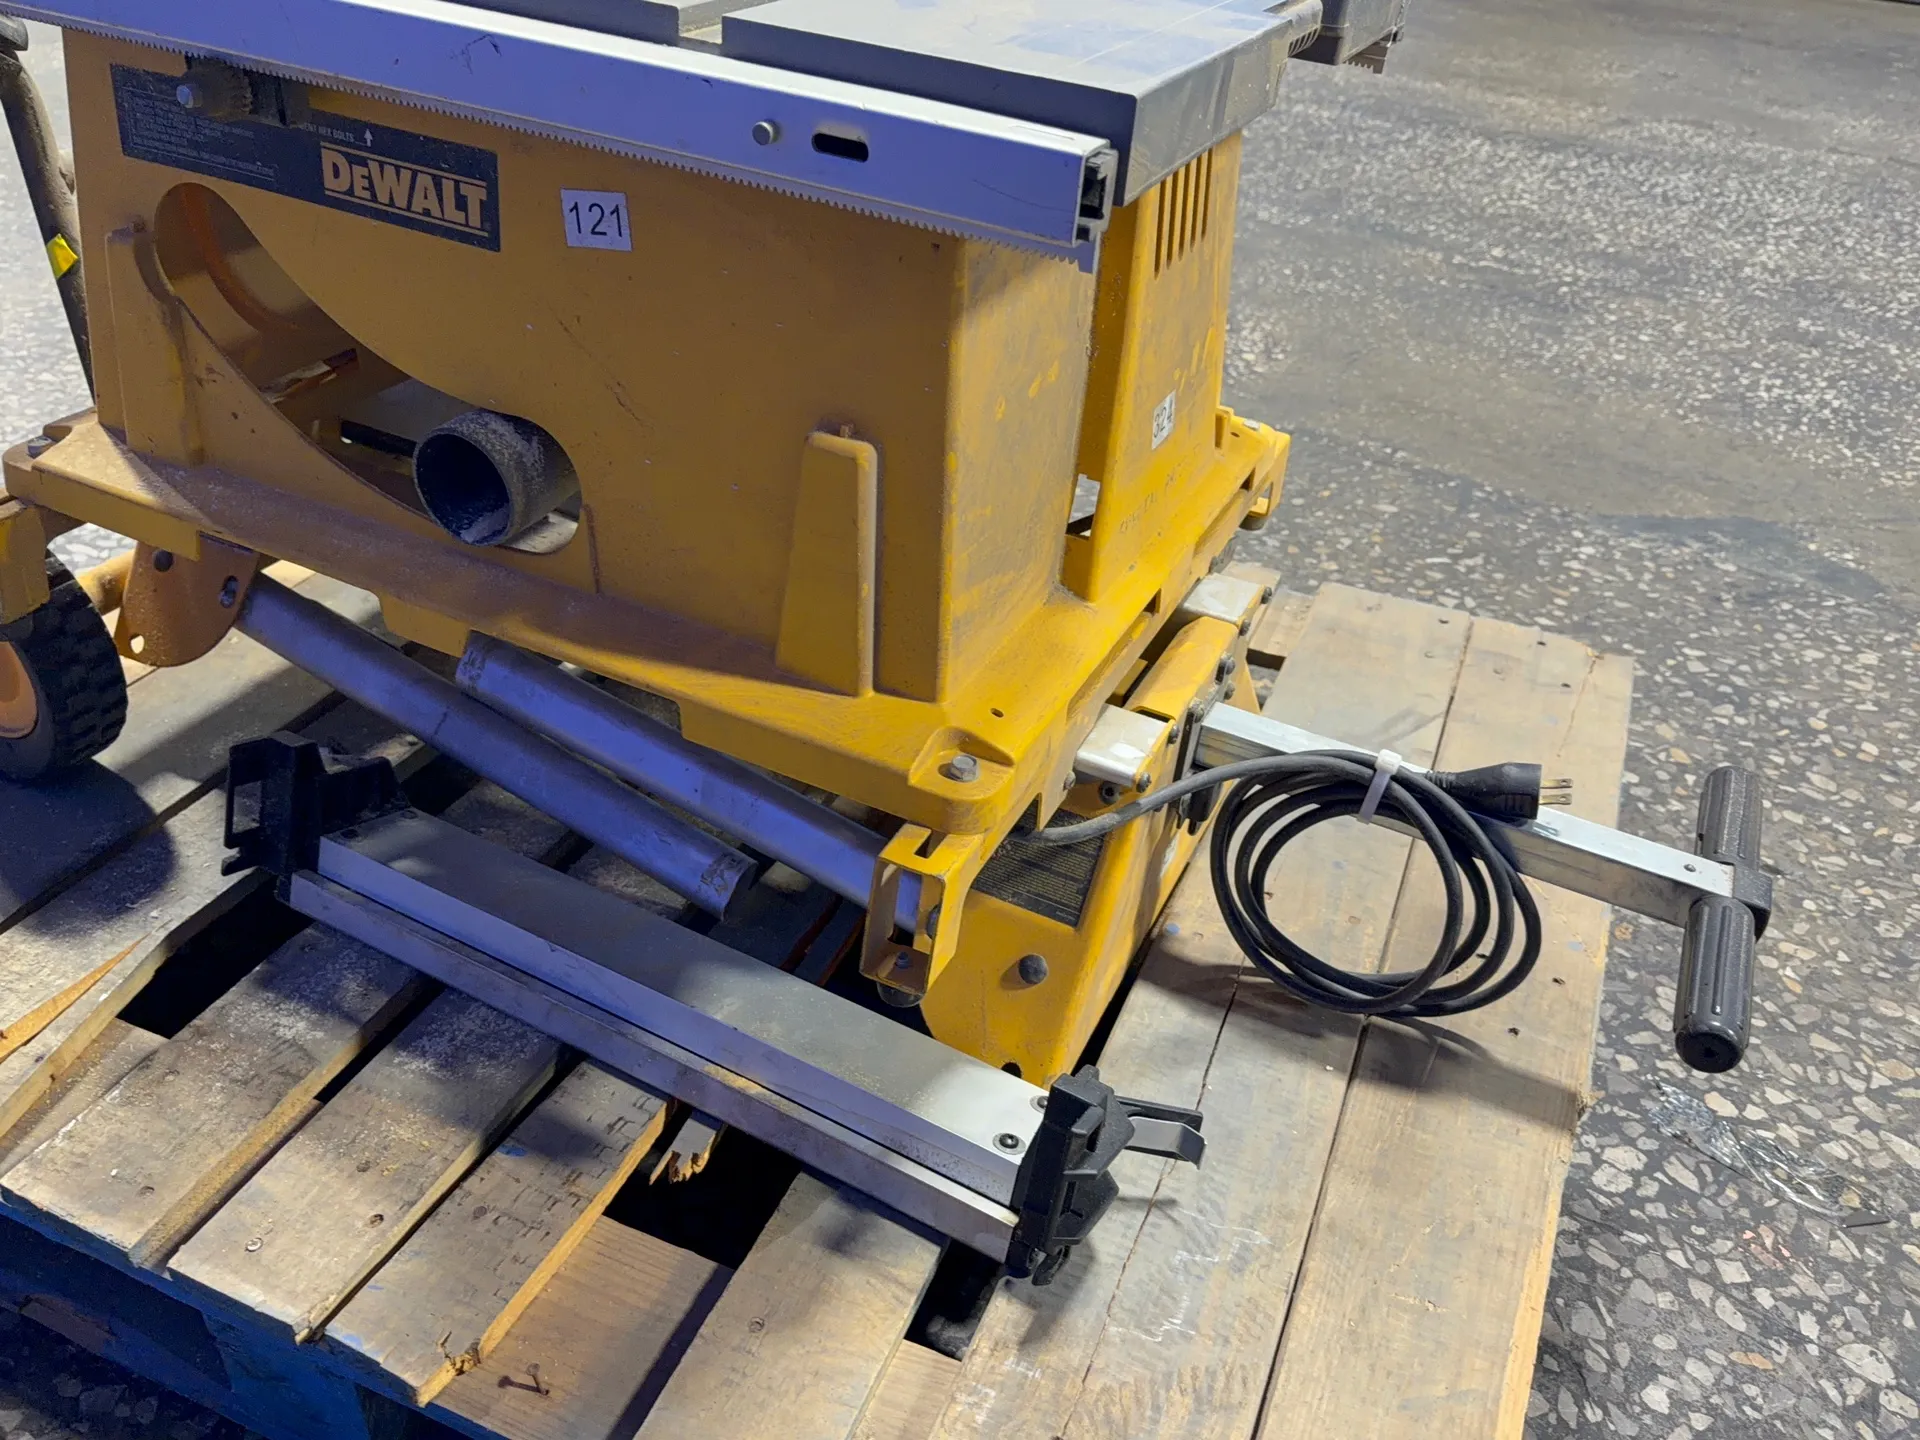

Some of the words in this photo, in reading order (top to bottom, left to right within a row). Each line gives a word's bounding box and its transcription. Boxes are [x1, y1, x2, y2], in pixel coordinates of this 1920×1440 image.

[332, 128, 355, 142] BOLTS
[569, 201, 623, 238] 121
[1153, 398, 1173, 438] 324
